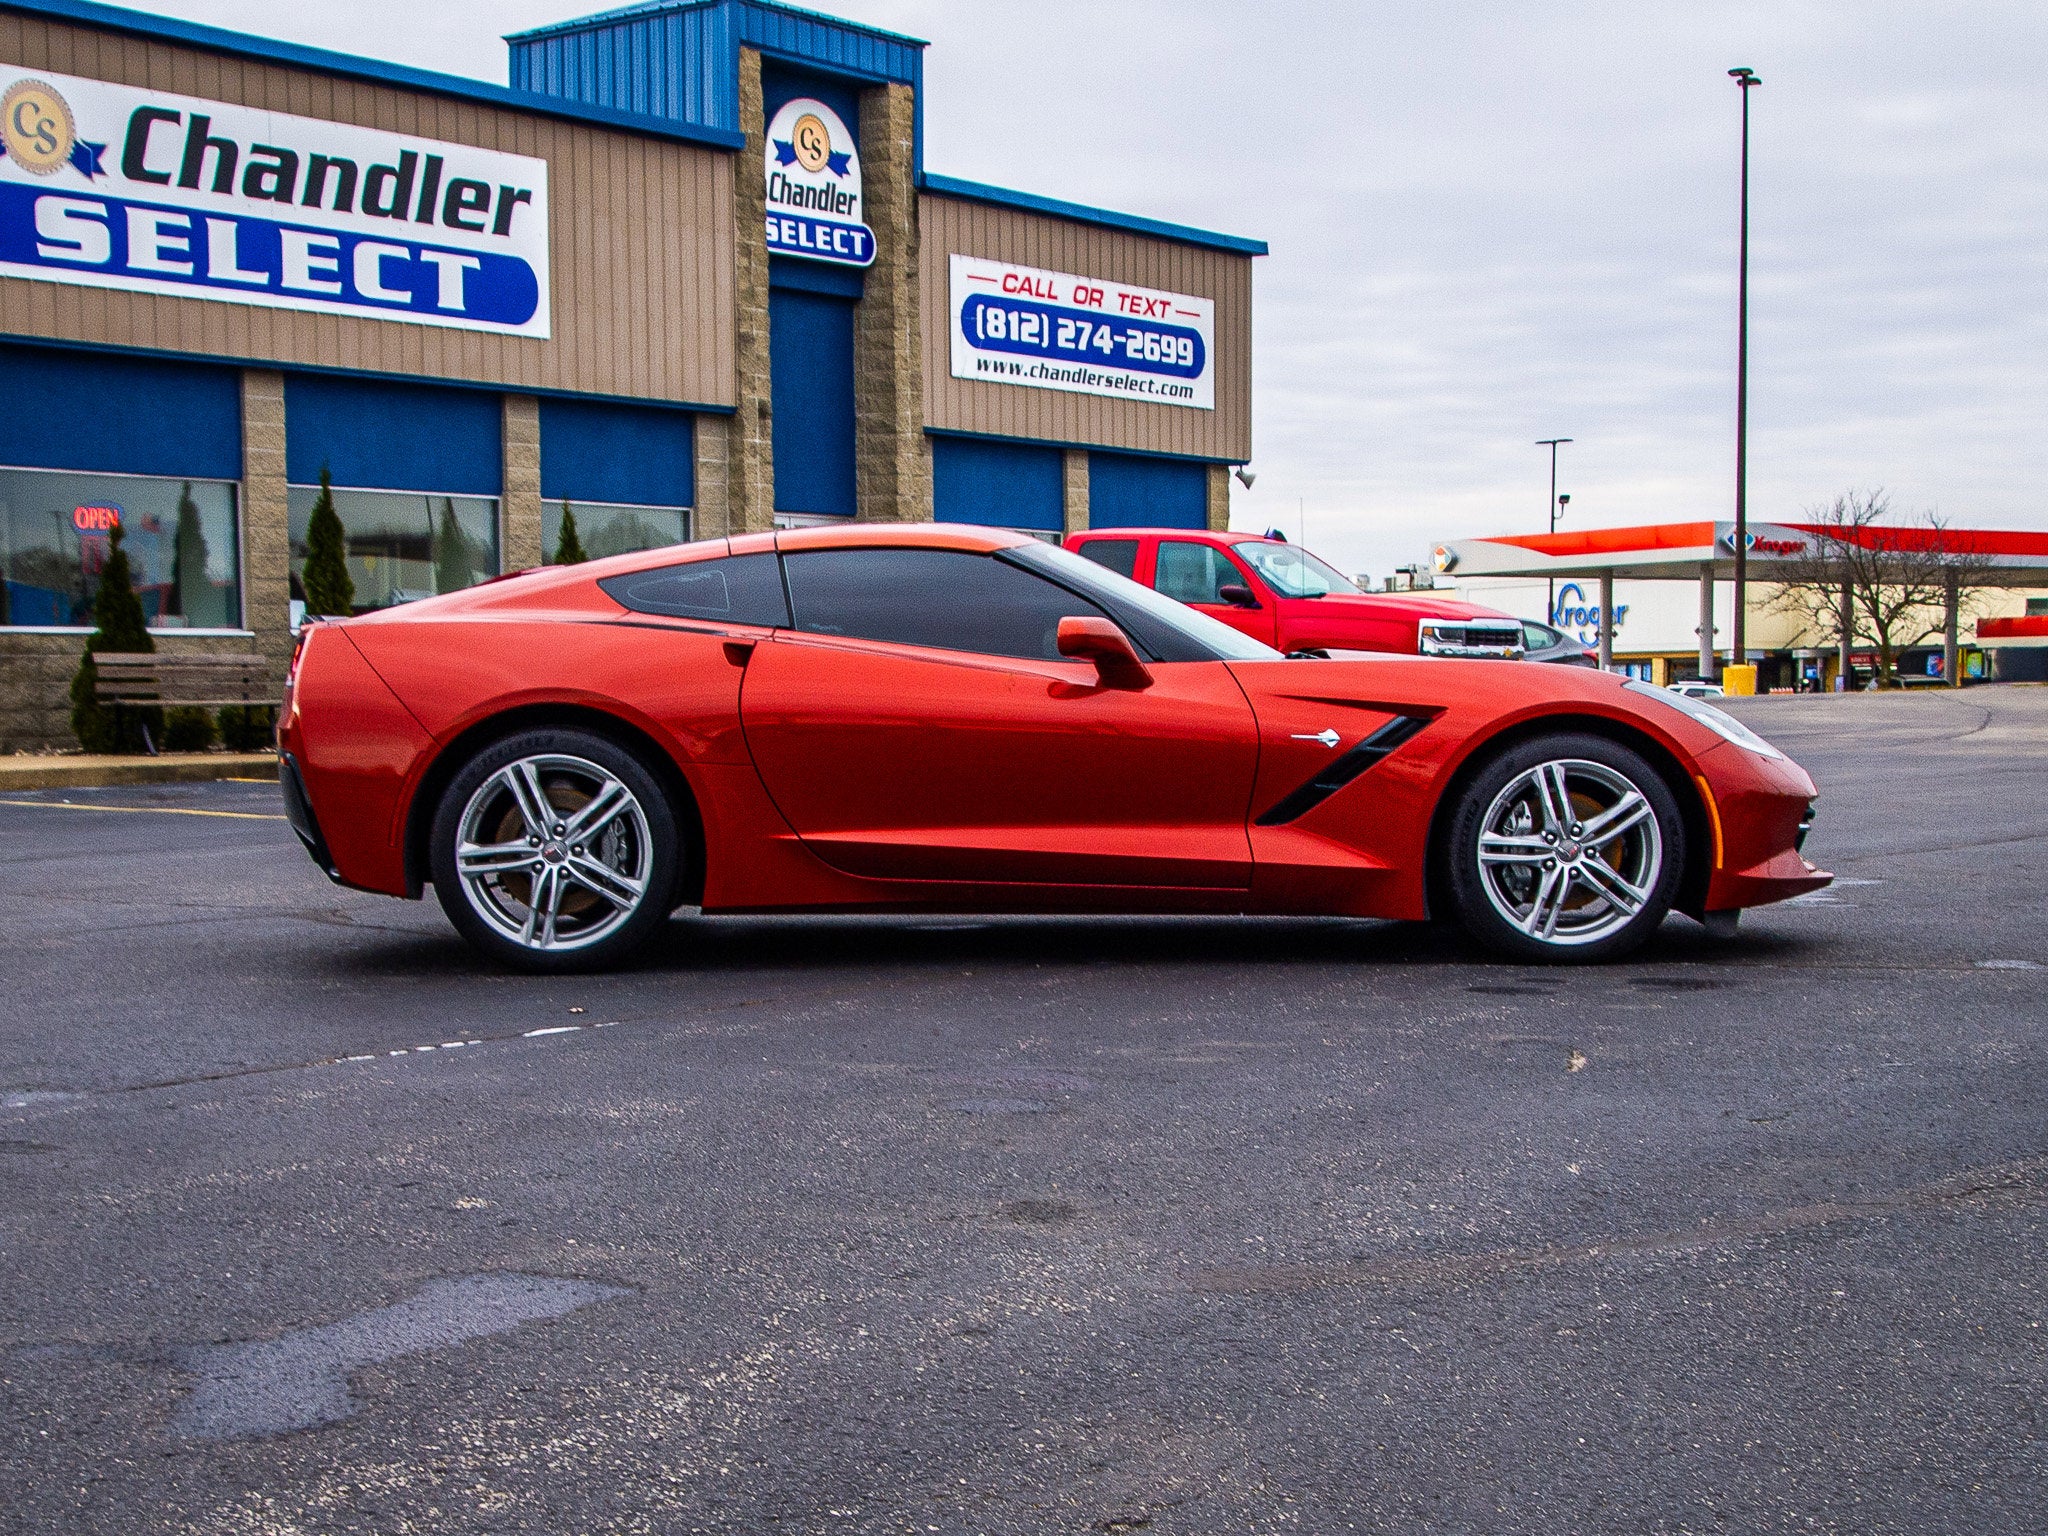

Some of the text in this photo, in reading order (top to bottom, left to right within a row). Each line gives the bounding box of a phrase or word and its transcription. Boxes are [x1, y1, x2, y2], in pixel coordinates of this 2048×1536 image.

[121, 104, 532, 238] Chandler
[769, 171, 857, 216] Chandler
[33, 194, 481, 311] SELECT
[766, 215, 866, 256] SELECT
[1002, 273, 1171, 318] CALL OR TEXT
[976, 303, 1194, 367] (812) 274-2699
[977, 357, 1194, 399] www.chandlerselect.com
[73, 506, 119, 530] OPEN
[1754, 535, 1807, 556] Kroger
[1552, 583, 1628, 649] Krogr
